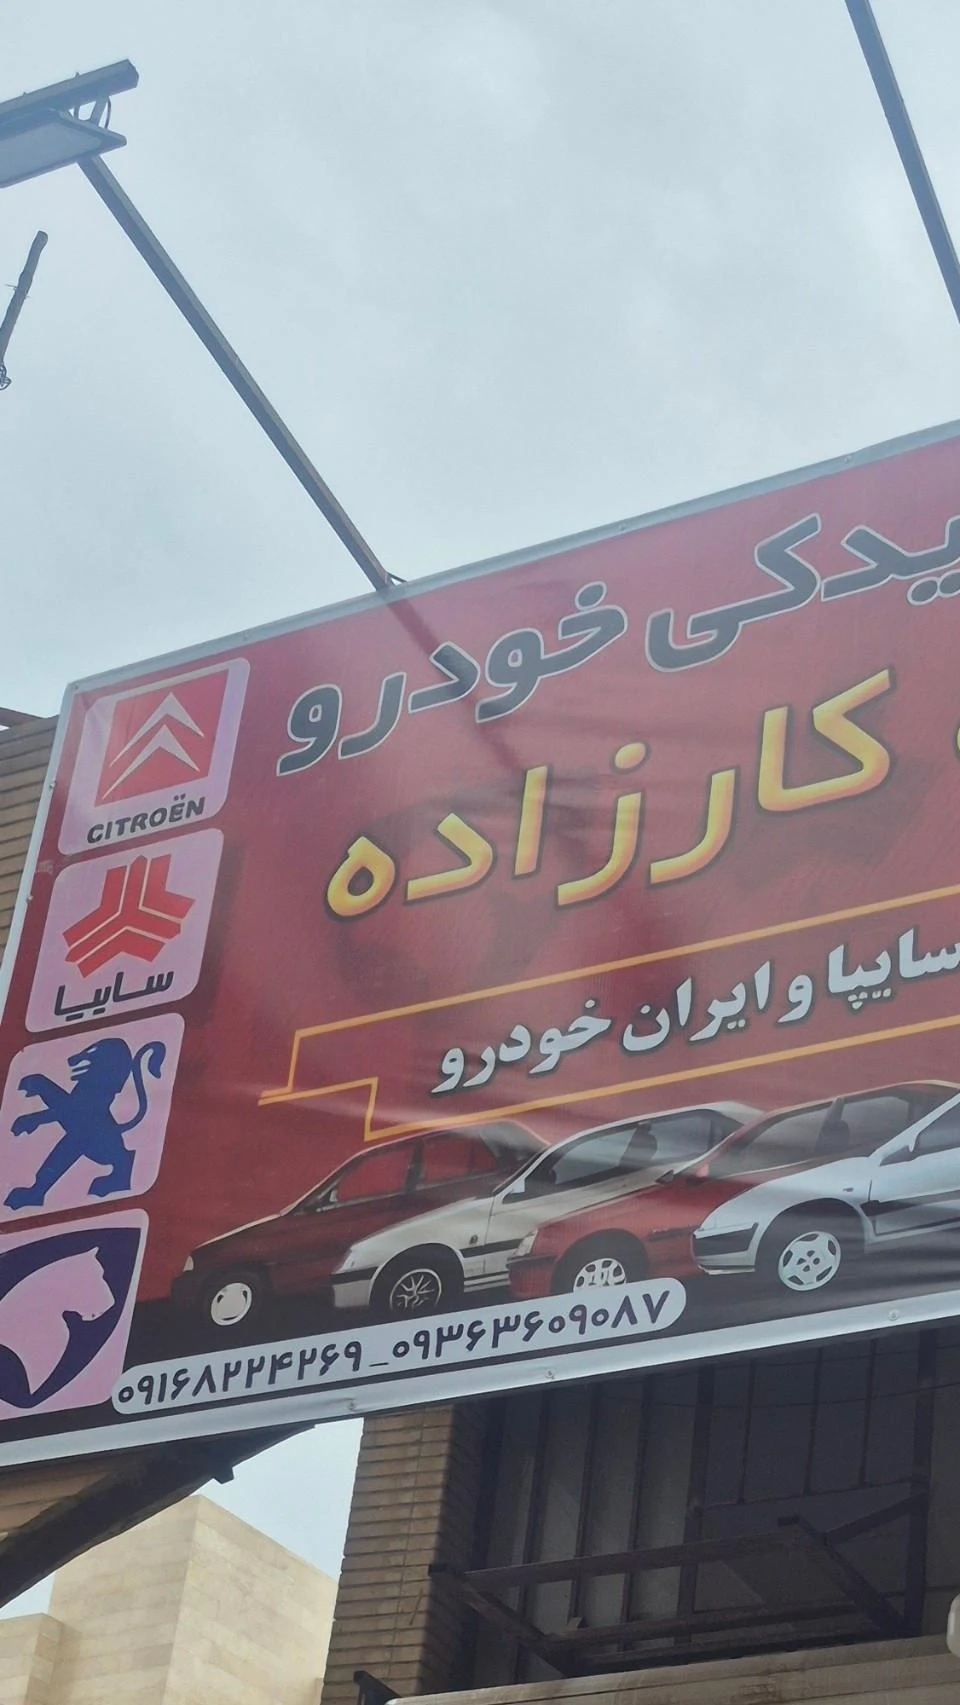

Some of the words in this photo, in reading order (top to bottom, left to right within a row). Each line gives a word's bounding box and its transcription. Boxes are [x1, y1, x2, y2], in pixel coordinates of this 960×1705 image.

[276, 580, 628, 776] خودرو
[86, 793, 206, 844] CITROËN
[54, 970, 175, 1023] سایپا
[621, 959, 772, 1053] ایران
[777, 972, 814, 1024] و
[430, 998, 612, 1094] خودرو
